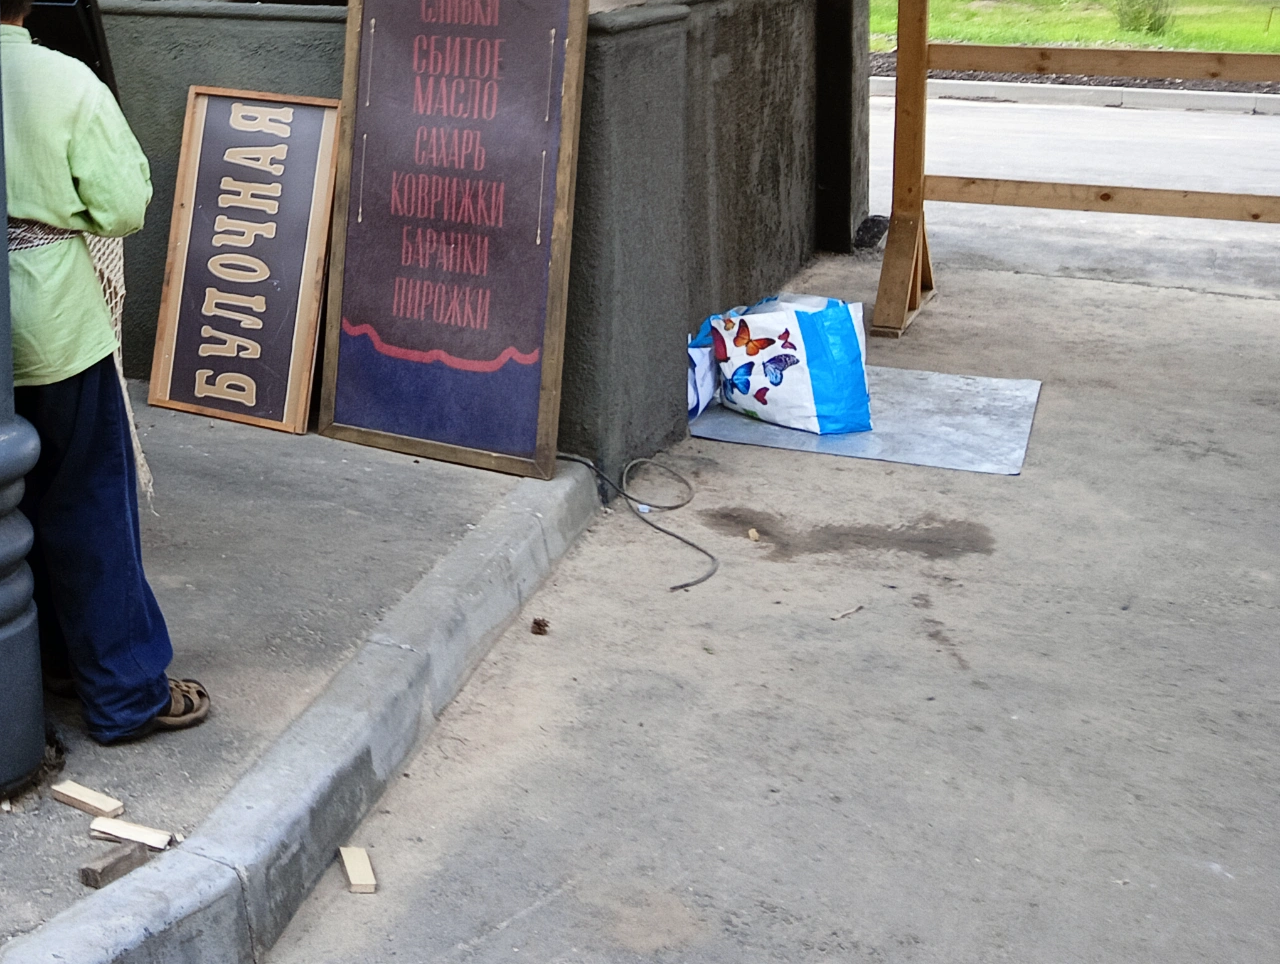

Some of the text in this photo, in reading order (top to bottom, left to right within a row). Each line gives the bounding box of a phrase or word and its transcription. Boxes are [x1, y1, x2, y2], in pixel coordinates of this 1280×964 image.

[413, 34, 506, 80] СБИТОЕ
[413, 76, 499, 121] МАСЛО
[414, 125, 486, 171] САХАРЪ
[390, 171, 505, 228] КОВРИЖКИ
[194, 102, 294, 406] БУЛОЧНАЯ
[401, 226, 489, 277] БАРАНКИ
[392, 277, 491, 330] ПИРОЖКИ
